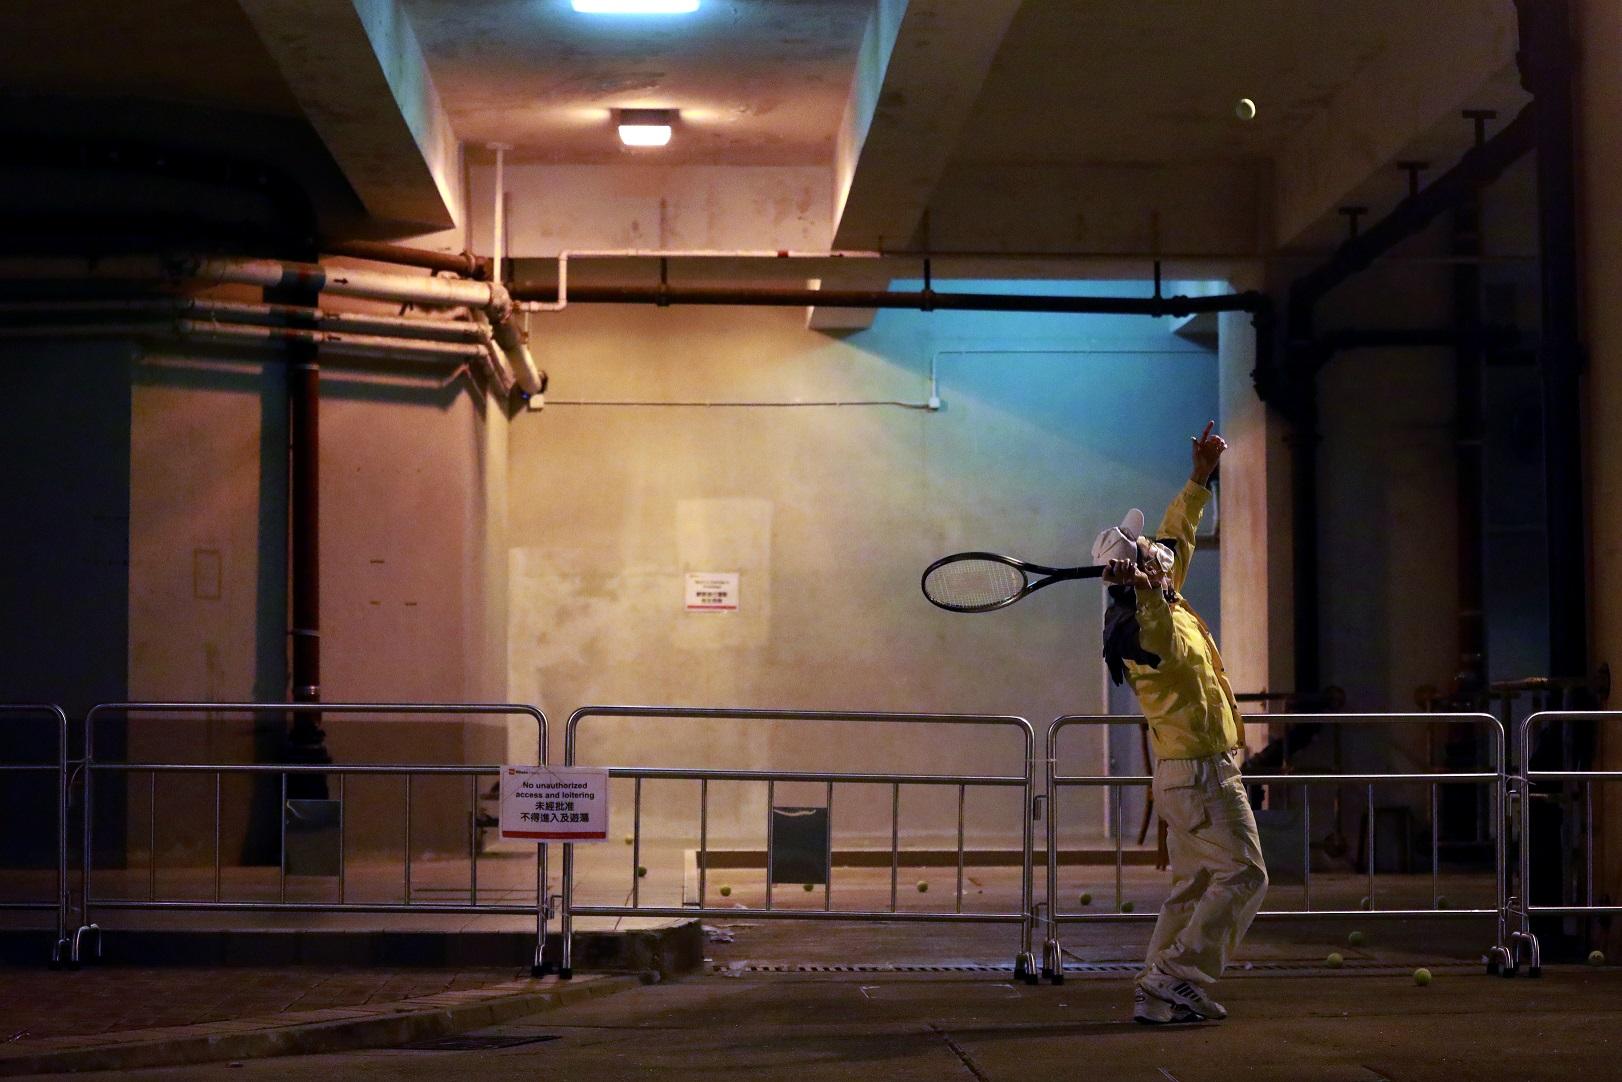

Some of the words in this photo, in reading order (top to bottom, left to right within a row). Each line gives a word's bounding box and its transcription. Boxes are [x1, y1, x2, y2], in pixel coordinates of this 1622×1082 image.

[523, 781, 534, 789] No
[536, 781, 588, 789] unauthorized
[562, 792, 595, 800] loitering
[535, 801, 575, 811] 未經批准
